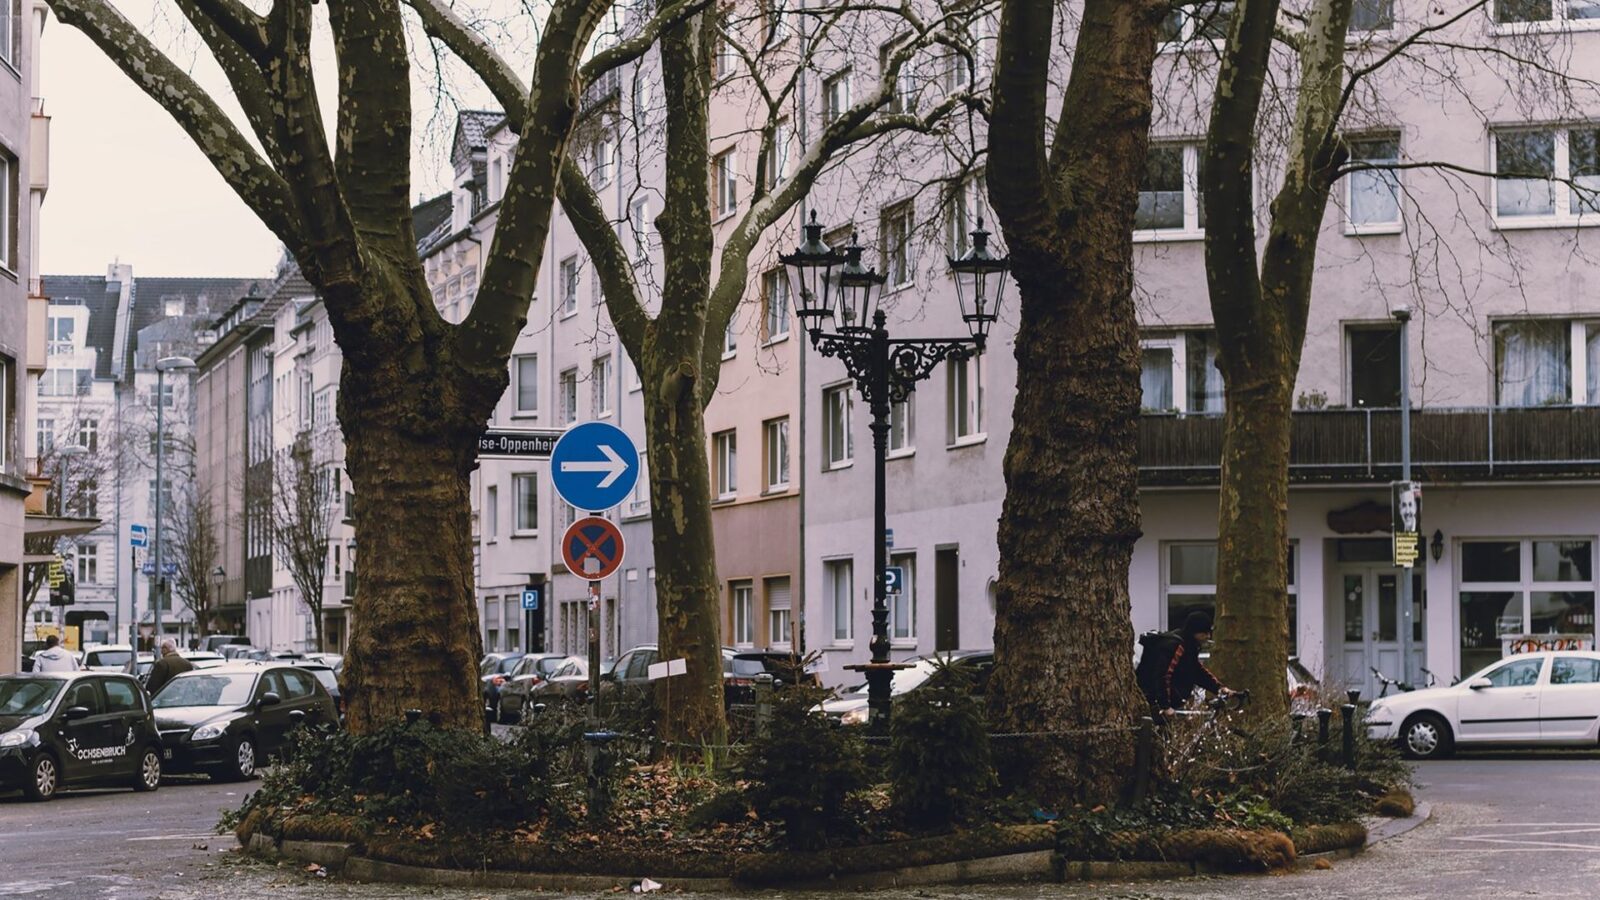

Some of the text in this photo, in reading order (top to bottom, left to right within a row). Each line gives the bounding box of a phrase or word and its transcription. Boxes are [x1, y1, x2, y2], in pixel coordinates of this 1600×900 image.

[479, 436, 555, 453] ise-Oppenhei
[525, 592, 535, 607] P
[77, 745, 126, 760] OCHSENBRUCH
